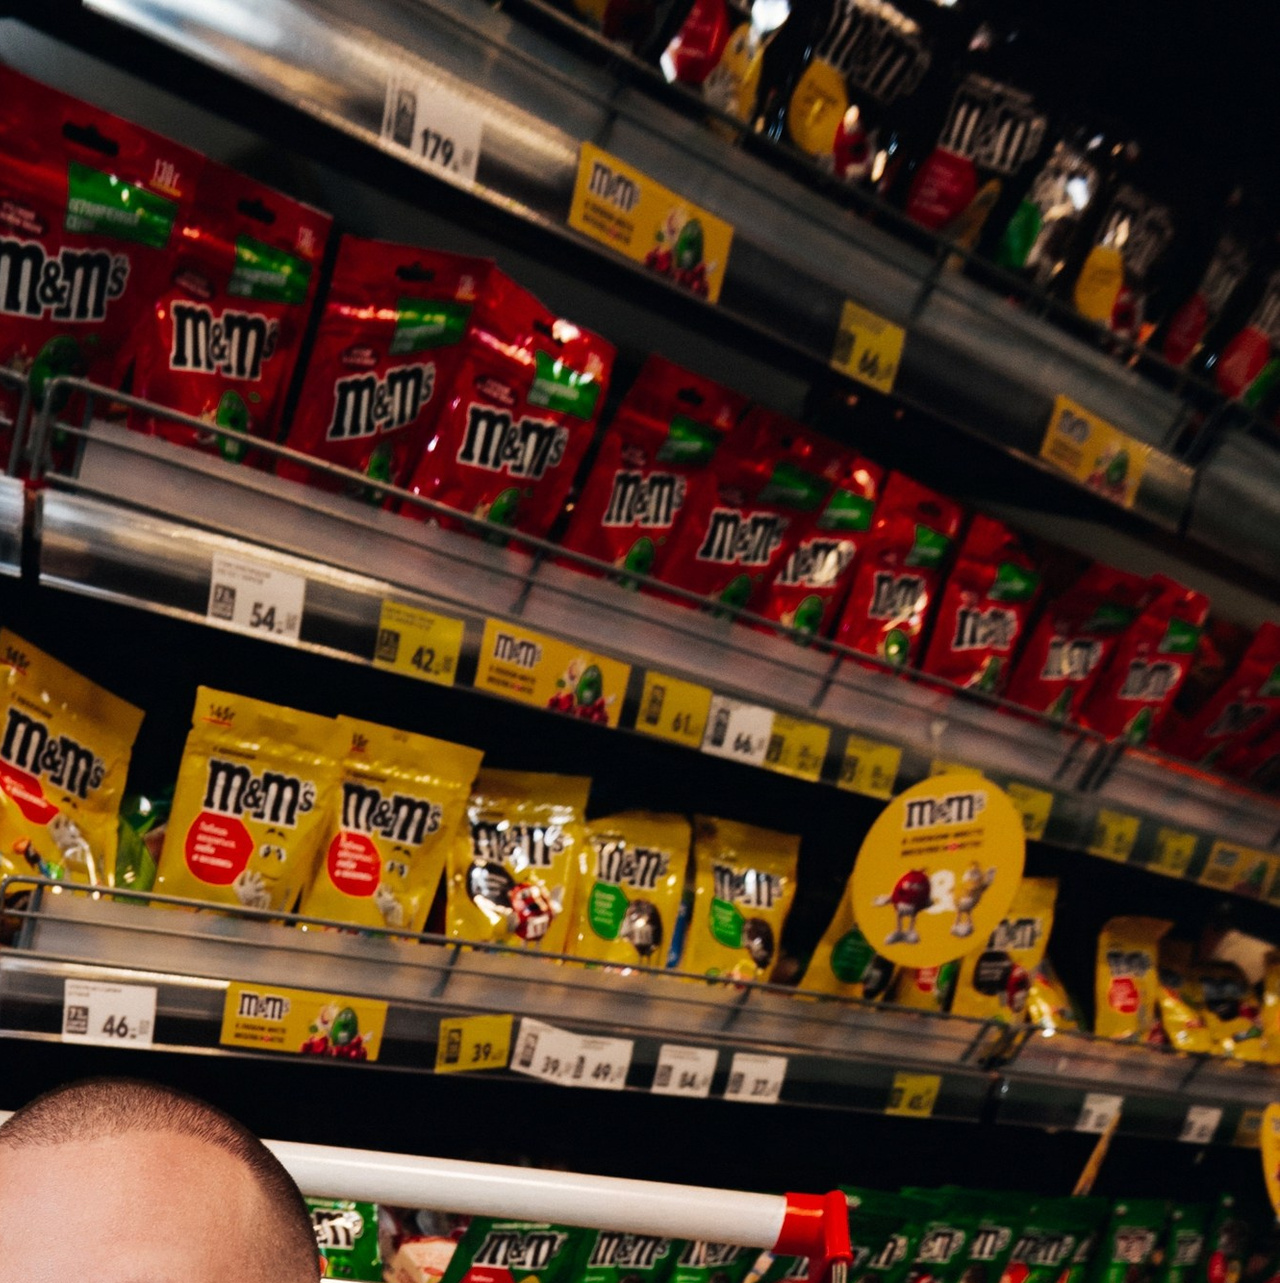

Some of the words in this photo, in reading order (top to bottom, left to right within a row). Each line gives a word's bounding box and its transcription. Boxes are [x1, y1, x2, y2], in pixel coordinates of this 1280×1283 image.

[421, 127, 454, 168] 179
[169, 299, 280, 381] m&m's
[326, 361, 436, 441] m&m's
[456, 401, 569, 480] m&m's
[250, 602, 276, 632] 54
[412, 646, 436, 673] 42
[0, 705, 106, 800] m&m's
[202, 757, 316, 830] m&m's
[340, 780, 443, 846] m&m's
[102, 1014, 128, 1038] 46
[472, 1042, 491, 1062] 39
[541, 1055, 559, 1074] 39
[591, 1060, 611, 1081] 49
